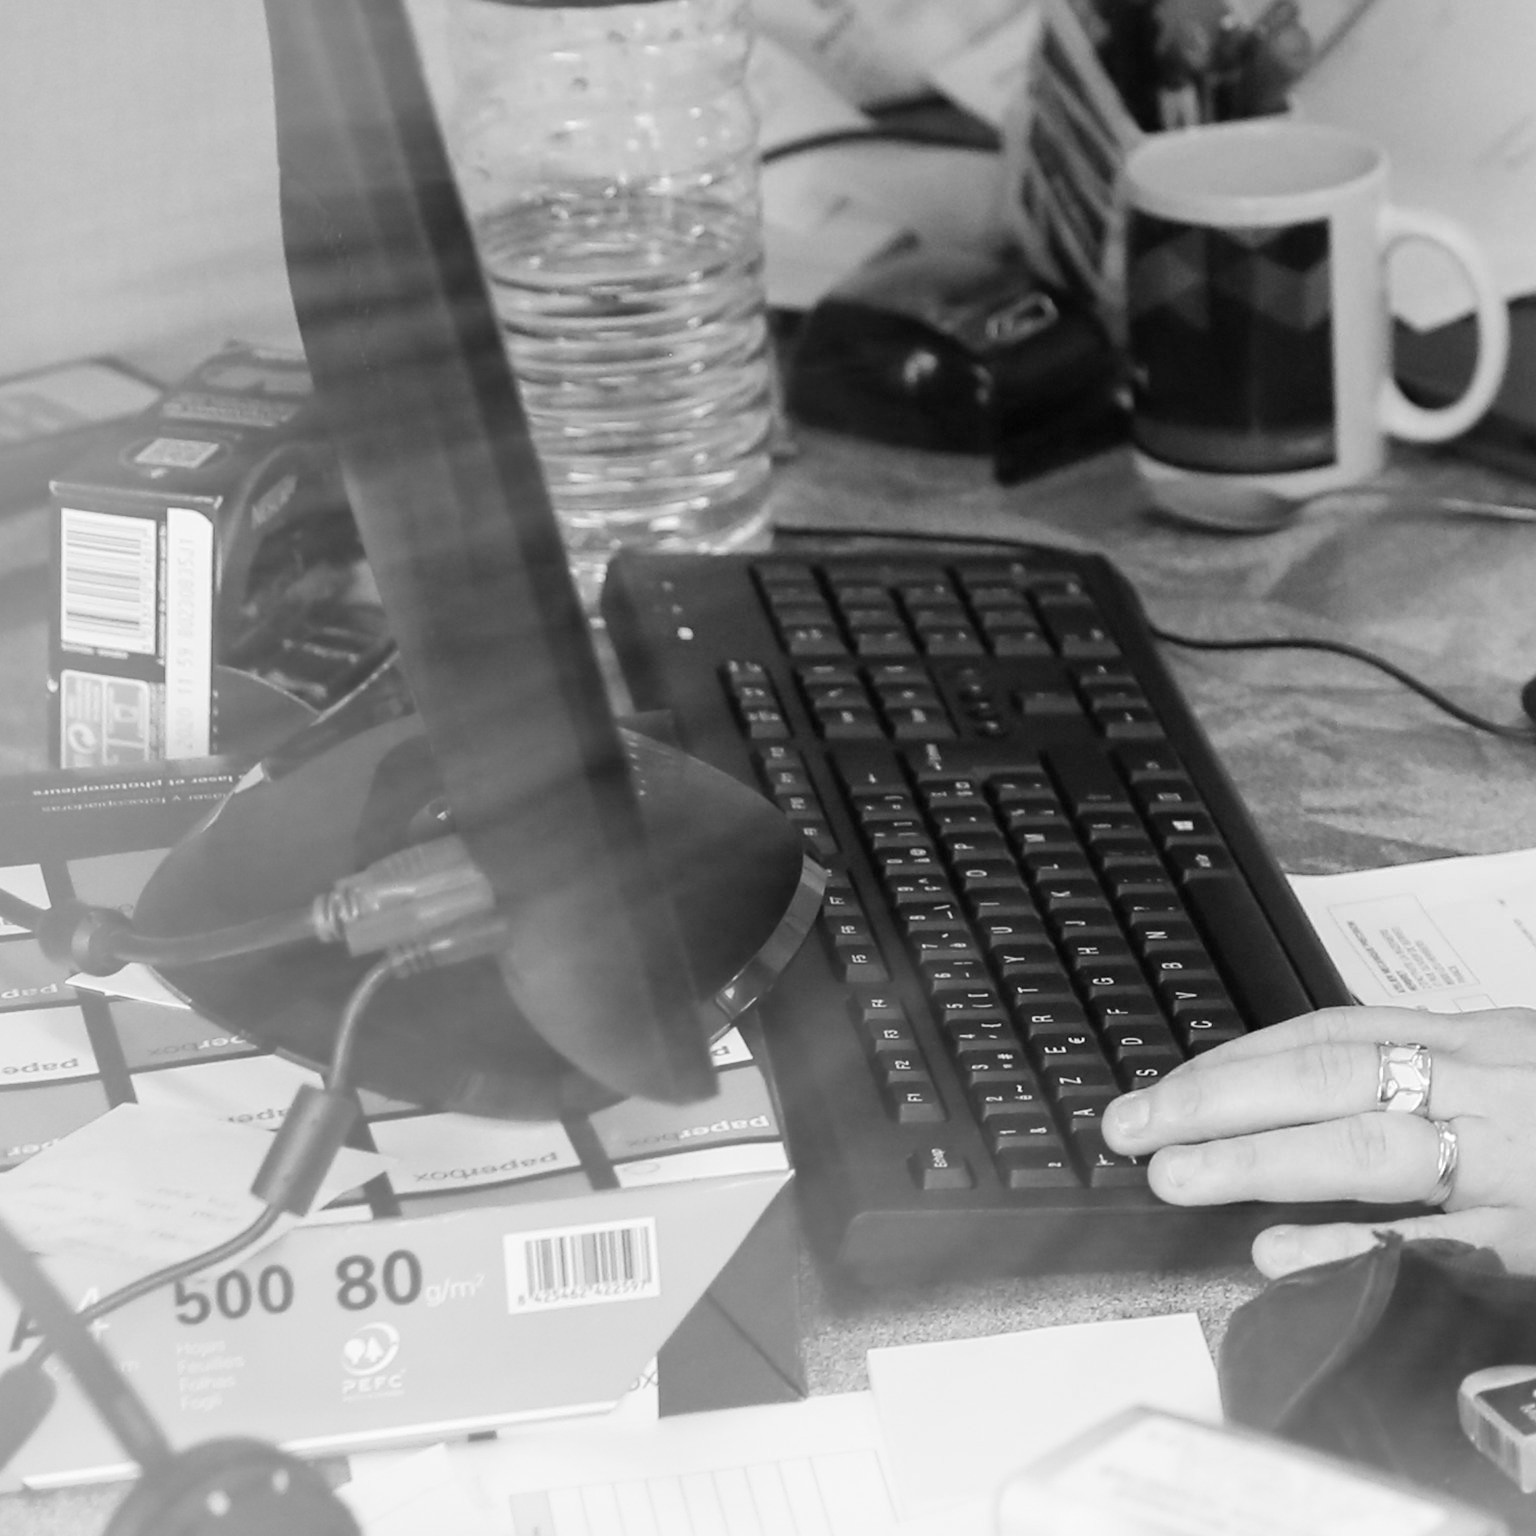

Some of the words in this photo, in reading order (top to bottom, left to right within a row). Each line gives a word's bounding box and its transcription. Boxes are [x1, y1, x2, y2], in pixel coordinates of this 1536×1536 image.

[1145, 931, 1168, 939] N
[1078, 947, 1099, 955] H
[1003, 955, 1025, 963] Y
[1092, 977, 1114, 986] G
[1175, 991, 1197, 1000] V
[1031, 1015, 1054, 1024] R
[1190, 1020, 1213, 1029] C
[1121, 1037, 1144, 1045] D
[1044, 1046, 1067, 1054] E
[1136, 1068, 1159, 1077] S
[1059, 1076, 1083, 1085] Z
[1073, 1107, 1096, 1116] A
[625, 1114, 771, 1149] paperbox
[414, 1151, 559, 1184] paperbox
[173, 1264, 294, 1326] 500
[335, 1249, 422, 1311] 80
[341, 1373, 403, 1395] PEFC
